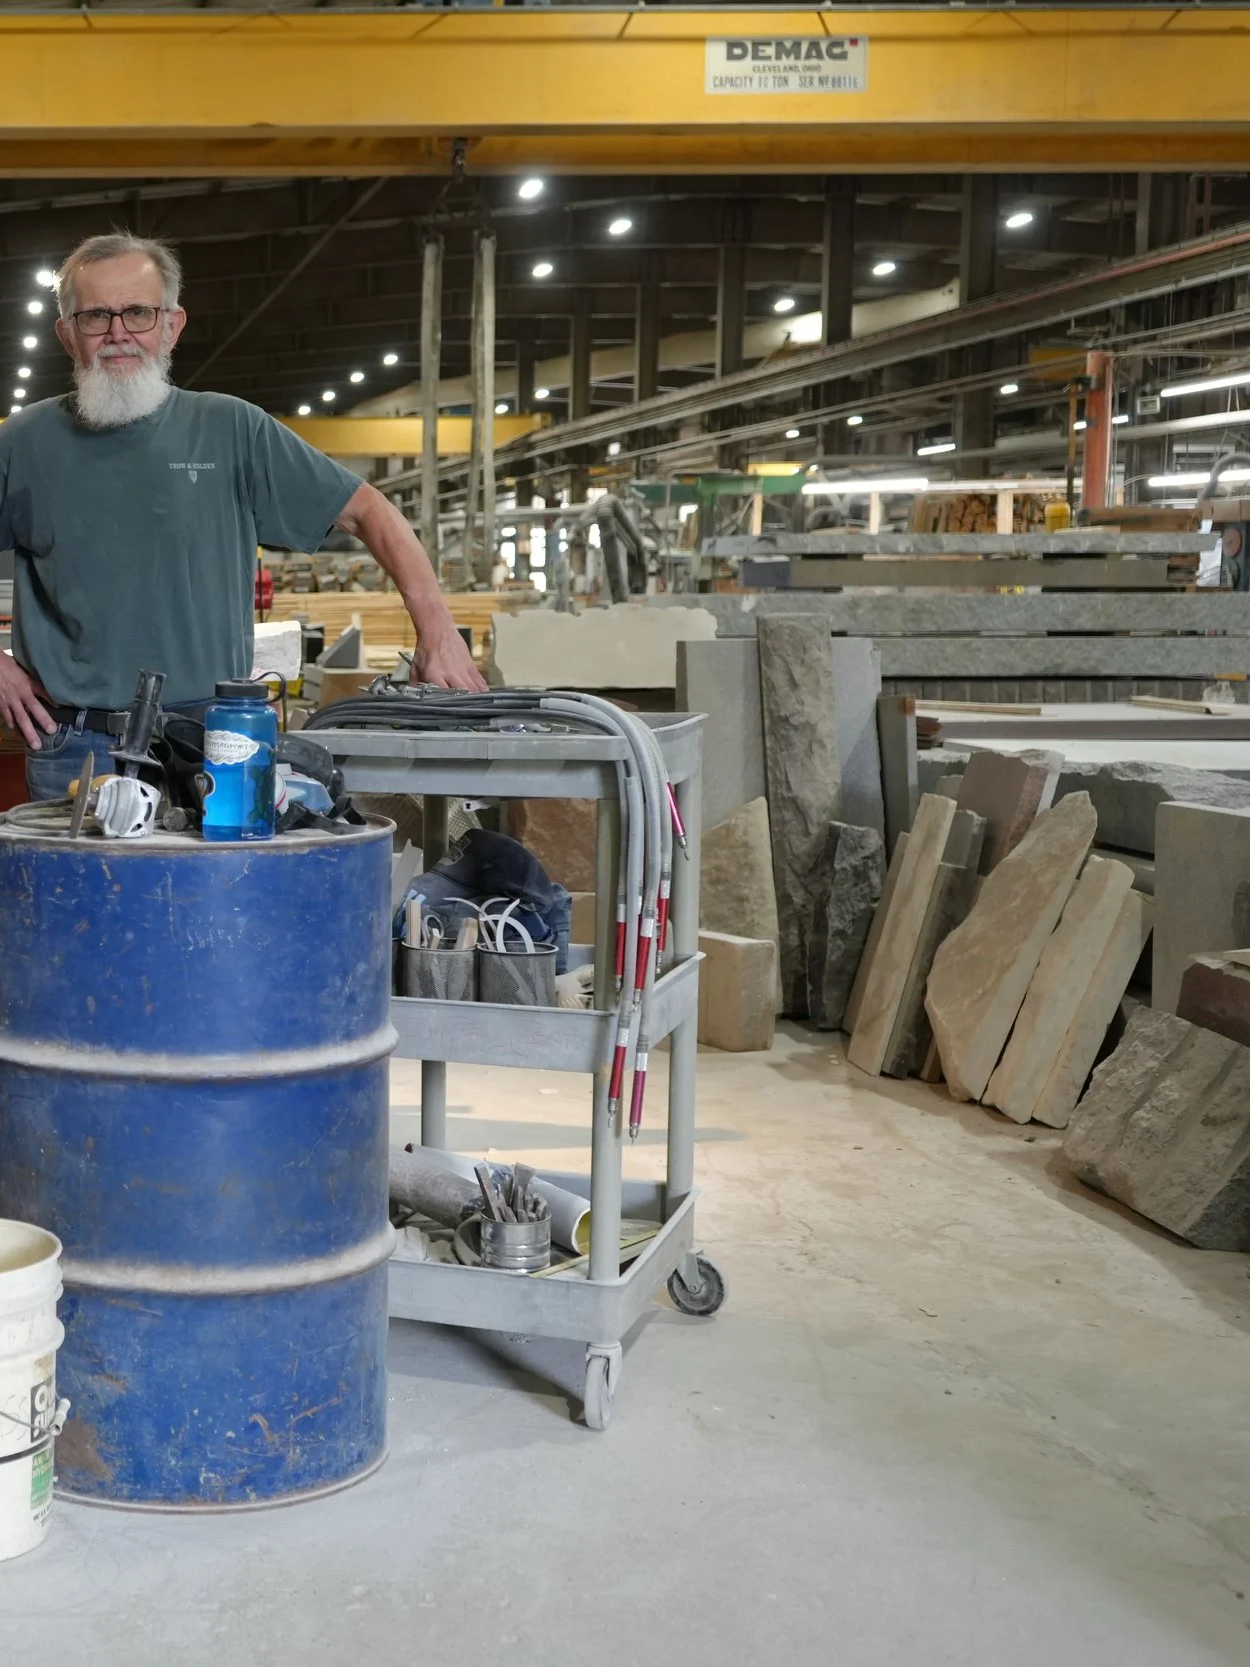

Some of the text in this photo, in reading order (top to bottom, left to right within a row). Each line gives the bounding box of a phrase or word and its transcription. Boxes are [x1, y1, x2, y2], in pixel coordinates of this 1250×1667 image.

[726, 42, 848, 61] DEMAG
[713, 76, 753, 88] CAPACITY
[772, 76, 789, 88] TON
